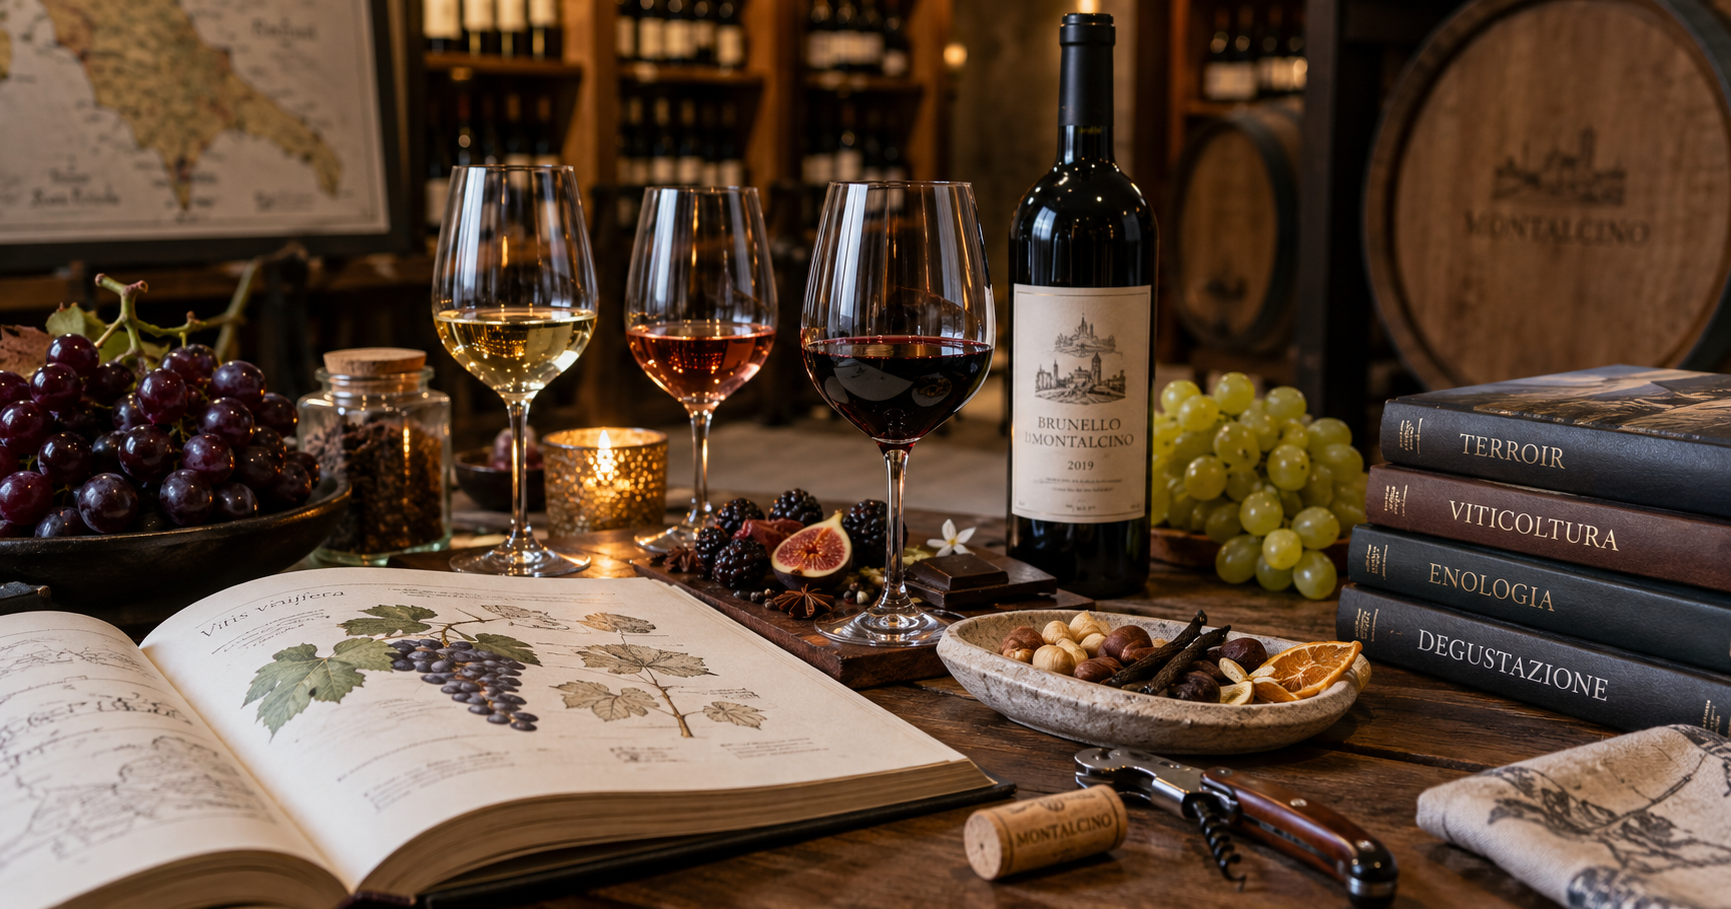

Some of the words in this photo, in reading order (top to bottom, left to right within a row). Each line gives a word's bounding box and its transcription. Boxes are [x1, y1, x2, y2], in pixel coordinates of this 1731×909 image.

[1464, 212, 1651, 248] MONTALCINO
[1038, 416, 1121, 431] BRUNELLO
[1067, 461, 1094, 470] 2019
[1460, 433, 1566, 470] TERROIR
[1449, 500, 1619, 552] VITICOLTURA
[1428, 562, 1555, 612] ENOLOGIA
[1416, 629, 1609, 702] DEGUSTAZIONE
[1016, 813, 1112, 846] MONTALCINO
